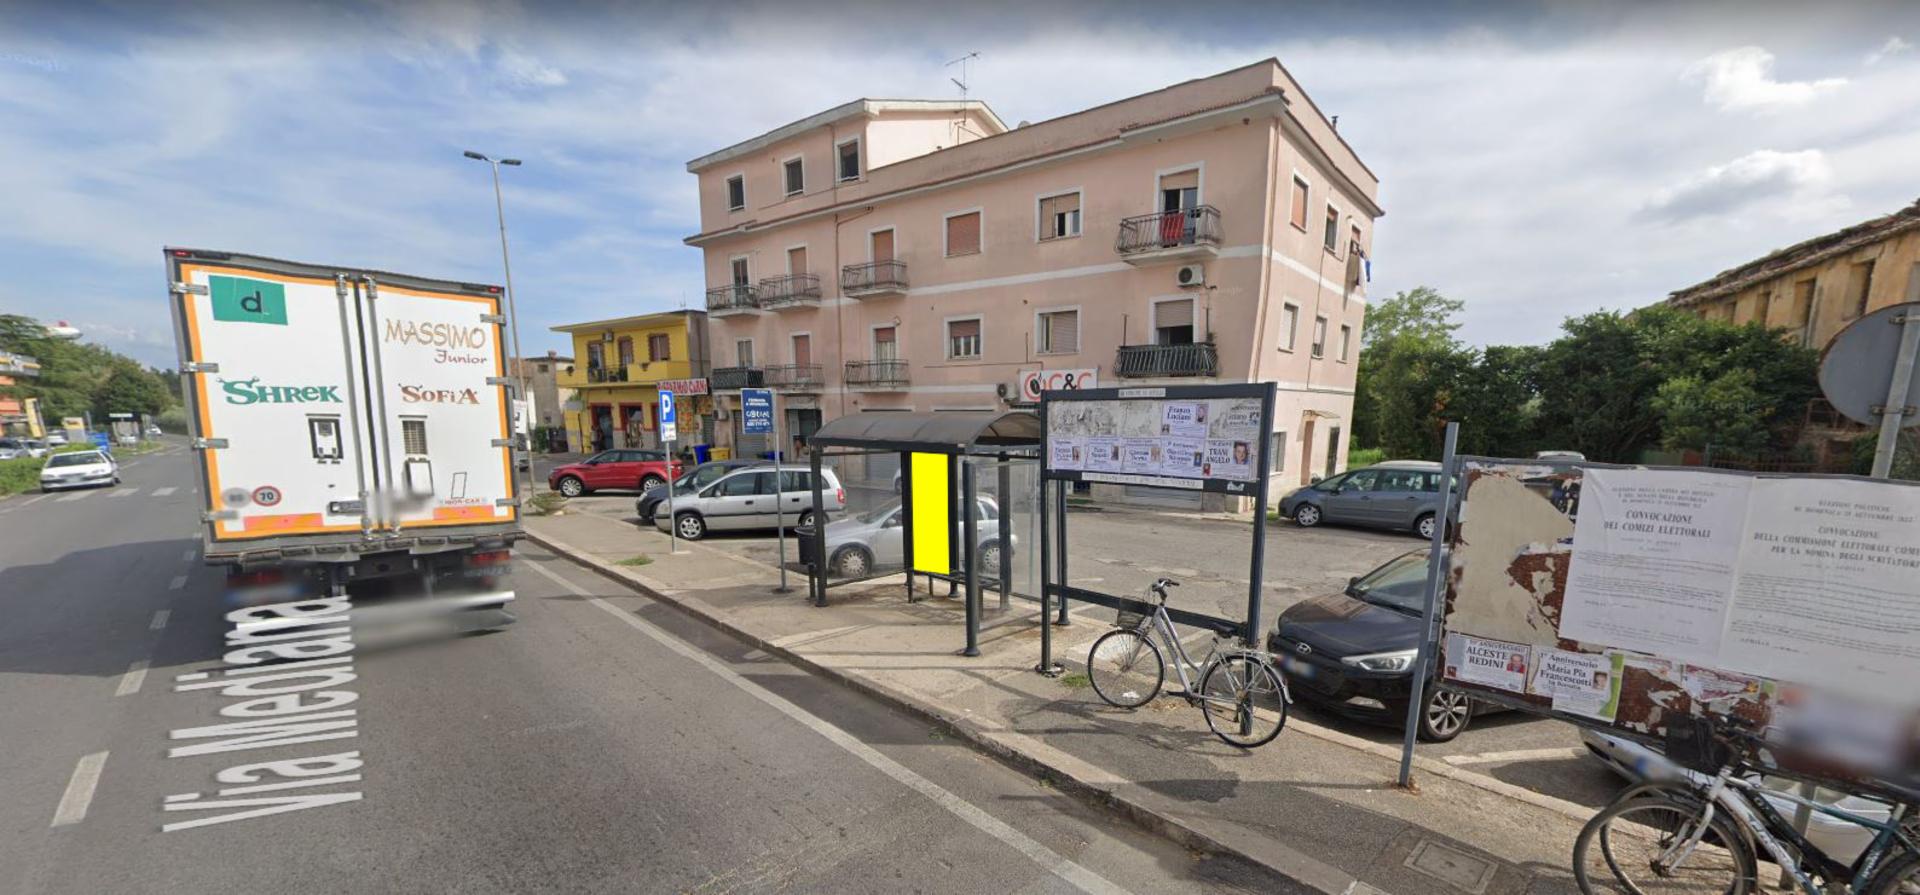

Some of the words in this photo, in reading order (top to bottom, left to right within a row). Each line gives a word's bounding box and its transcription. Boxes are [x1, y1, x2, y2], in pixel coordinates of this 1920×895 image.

[240, 290, 262, 313] d
[385, 319, 486, 349] MASSIMO
[434, 349, 487, 364] Junior
[662, 394, 671, 420] P
[259, 492, 274, 501] 70
[1626, 509, 1693, 524] CONVOCAZIONE
[1604, 521, 1618, 530] DEI
[1622, 521, 1654, 533] COMIZI
[1658, 526, 1712, 538] ELETTORALI
[1818, 526, 1879, 539] CONVOCAZIONE
[1754, 532, 1779, 542] DELLA
[1841, 541, 1890, 553] ELETTORALE
[1839, 552, 1864, 562] DEGLI
[1466, 646, 1506, 660] ALCESTE
[1469, 655, 1504, 669] REDINI
[1551, 654, 1599, 669] Anniversario
[1547, 664, 1571, 675] Maria
[1573, 668, 1586, 678] Pia
